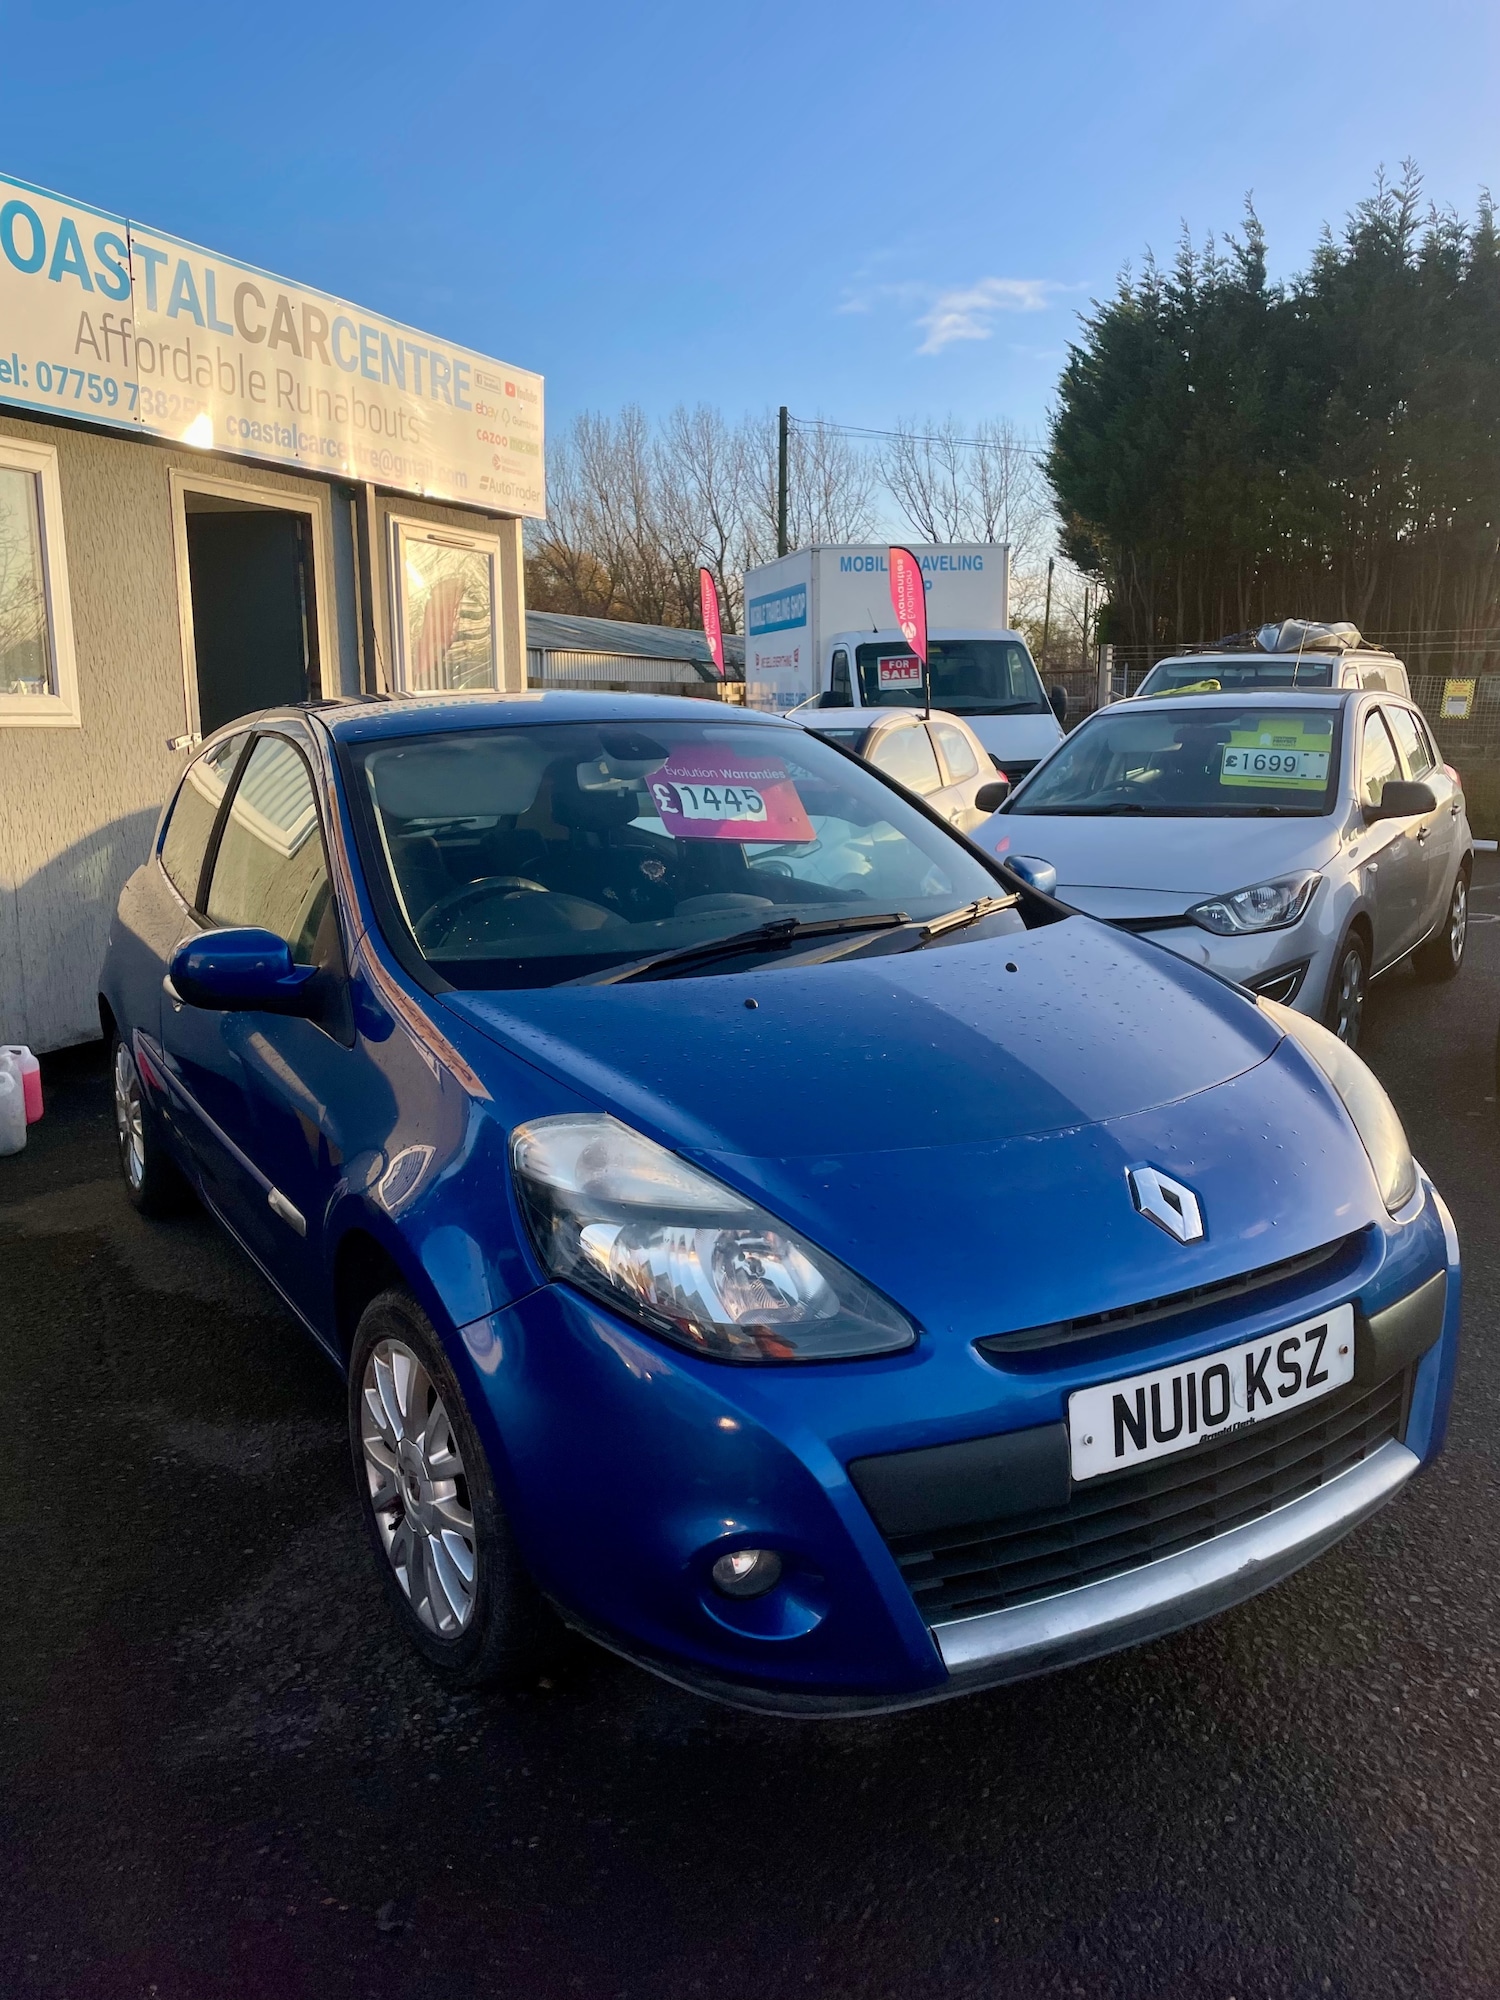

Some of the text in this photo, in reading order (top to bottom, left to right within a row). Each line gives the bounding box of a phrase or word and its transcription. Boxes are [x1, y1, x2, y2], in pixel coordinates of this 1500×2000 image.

[36, 360, 118, 406] 07759
[74, 311, 420, 444] Affordable Runabouts
[476, 400, 499, 422] ebay
[226, 415, 468, 488] coastalcarcetre@gmailcom
[489, 477, 541, 502] AutoTrader
[840, 555, 984, 572] MOBIL AVELING
[882, 668, 918, 679] SALE
[889, 660, 909, 669] FOR
[663, 764, 786, 780] Evolution Warranties
[1225, 753, 1297, 773] £1699
[652, 783, 764, 814] £1445
[1112, 1324, 1329, 1457] NU10 KSZ
